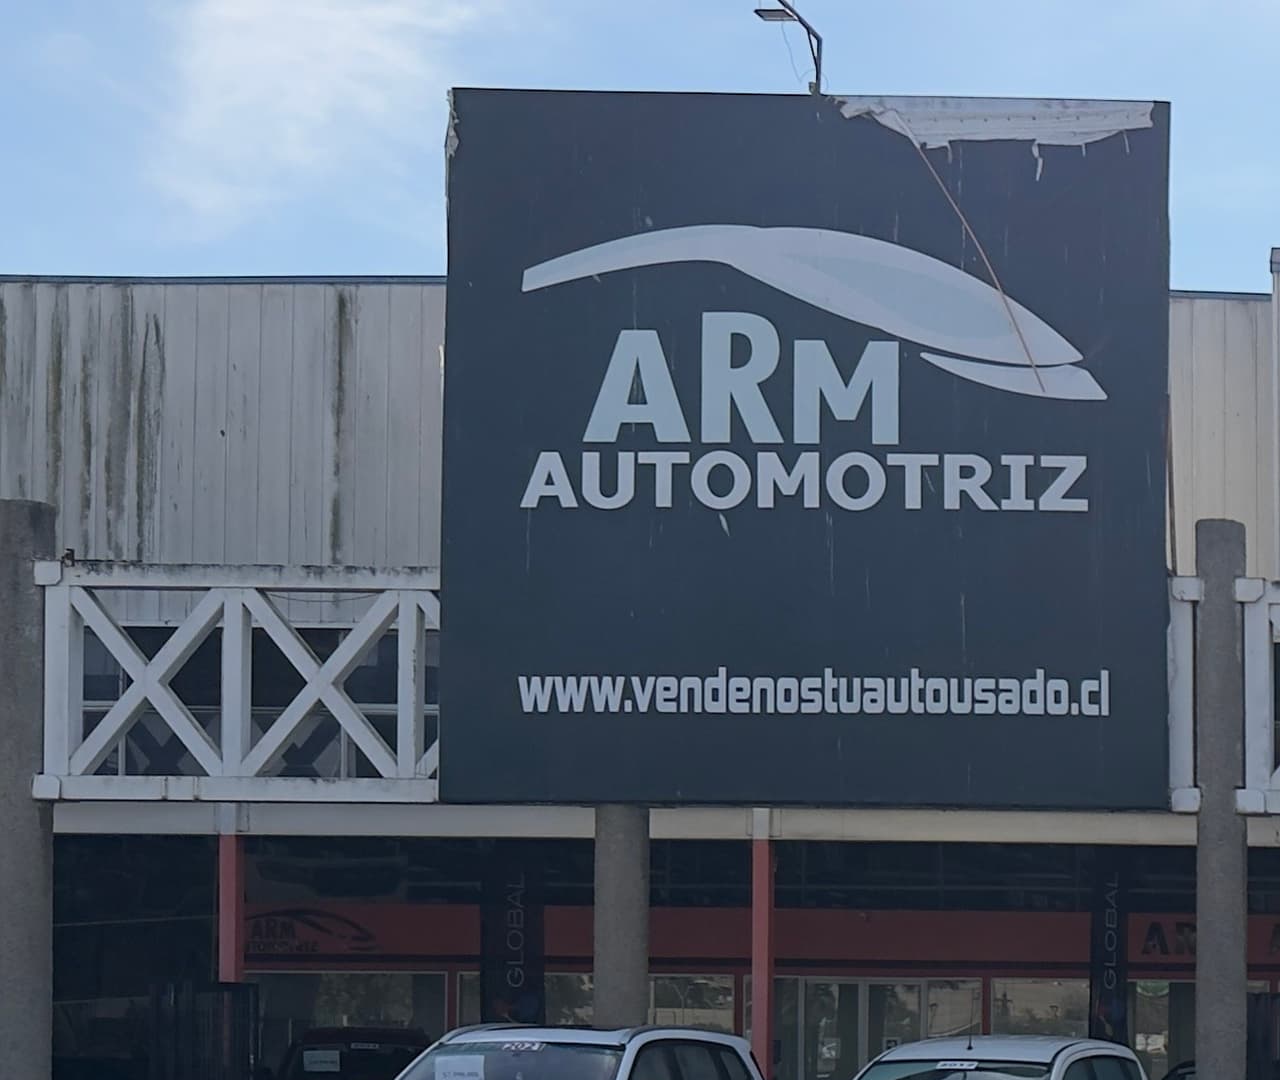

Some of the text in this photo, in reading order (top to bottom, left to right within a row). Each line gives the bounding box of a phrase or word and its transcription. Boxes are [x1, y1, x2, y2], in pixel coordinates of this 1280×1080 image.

[582, 311, 899, 445] ARM
[519, 450, 1089, 513] AUTOMOTRIZ
[518, 667, 1110, 716] www.vendenostuautousado.cl
[506, 871, 526, 989] GLOBAL
[1103, 871, 1119, 991] GLOBAL
[1142, 922, 1197, 956] AR
